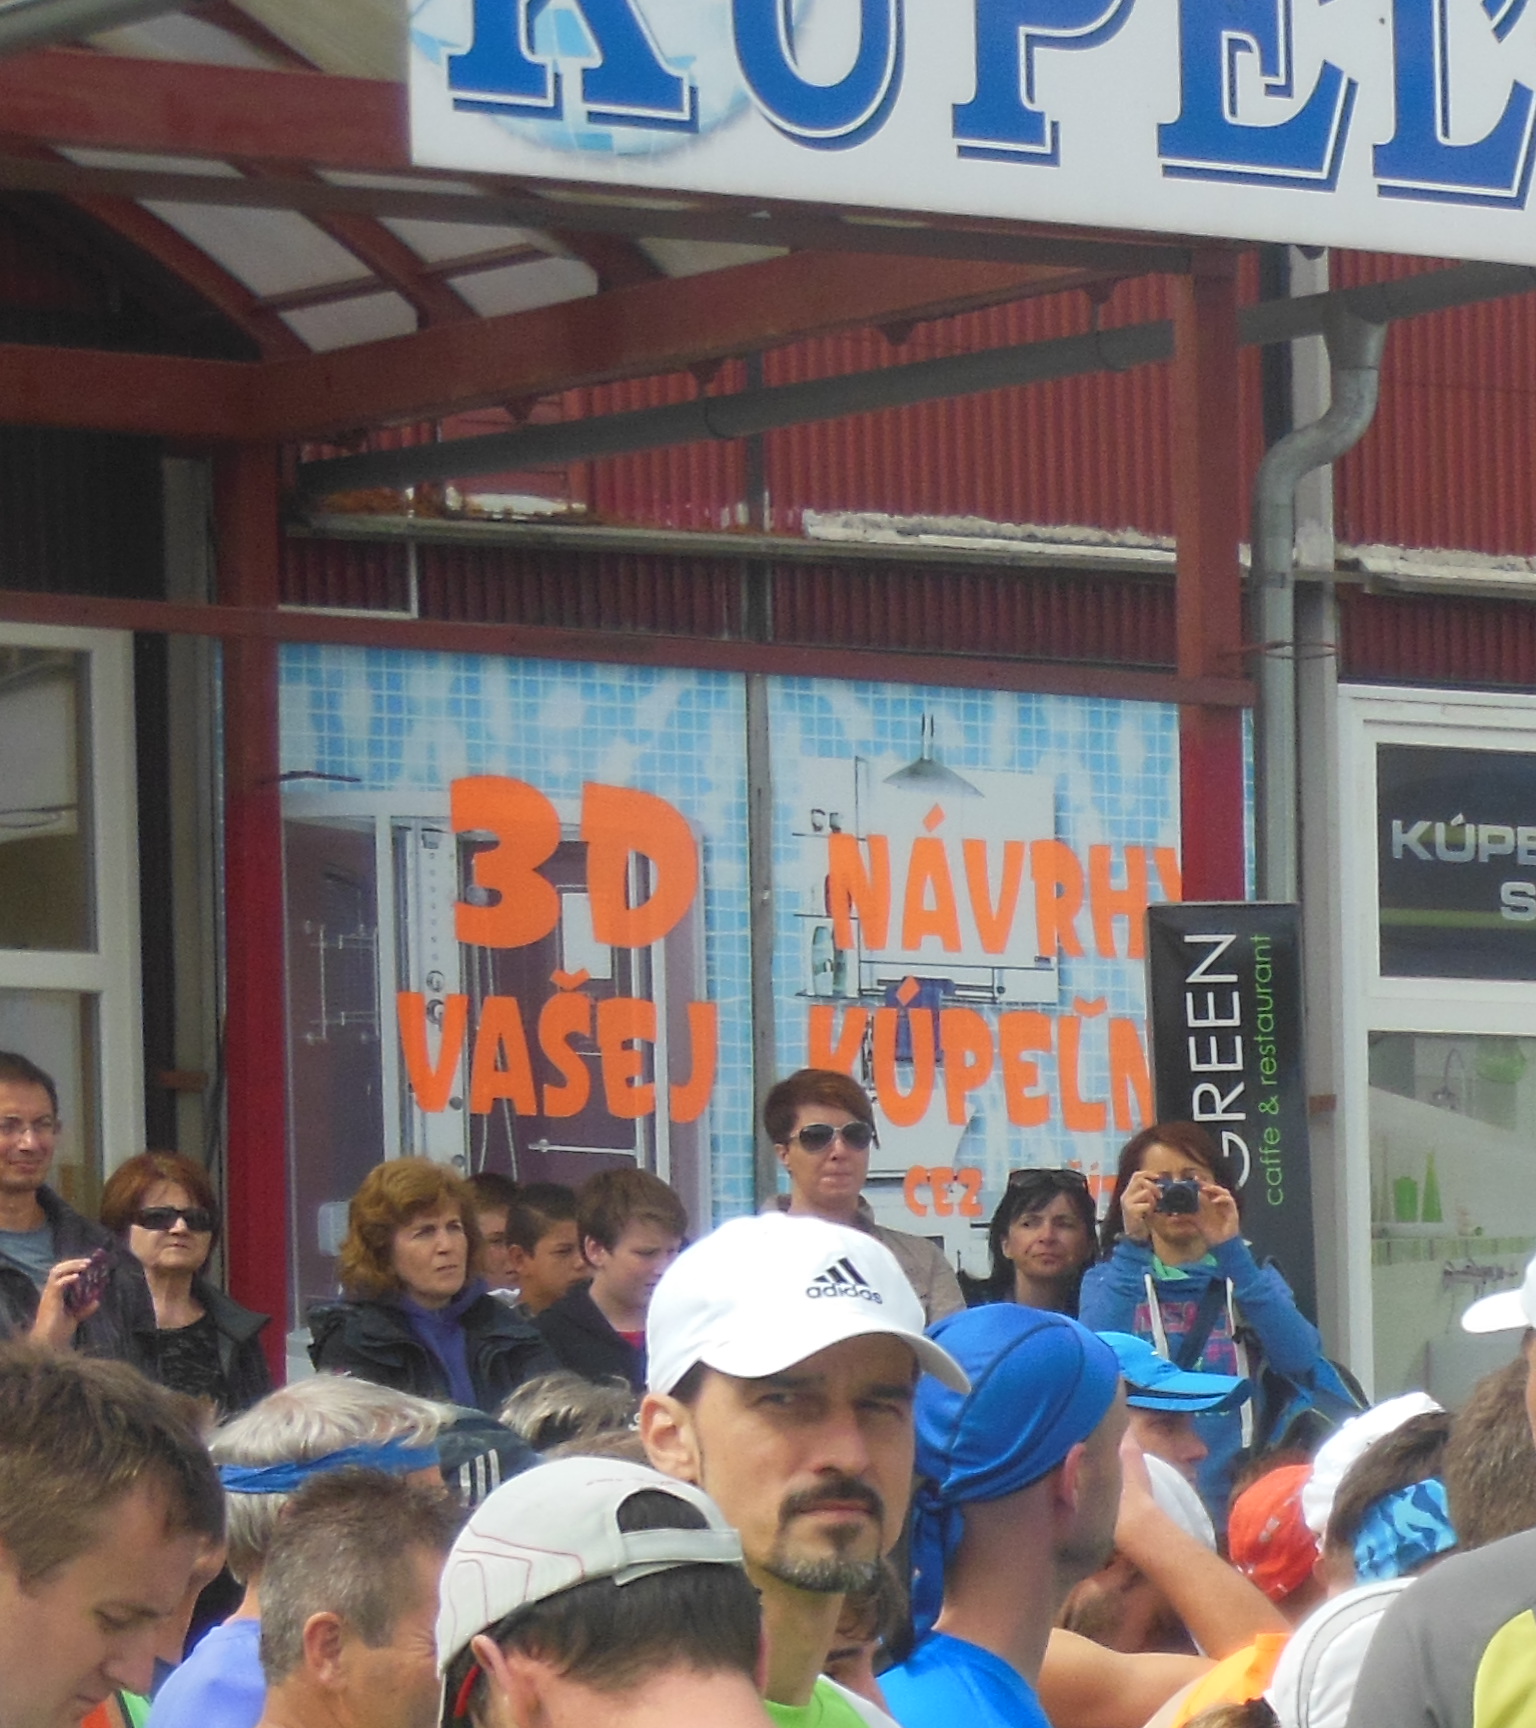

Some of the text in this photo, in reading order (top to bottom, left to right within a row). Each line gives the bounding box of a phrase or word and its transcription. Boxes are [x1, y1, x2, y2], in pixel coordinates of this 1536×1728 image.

[451, 774, 699, 949] 3D
[397, 967, 1156, 1133] VAŠEJ KÚPEĽN
[1250, 932, 1285, 1206] caffe & restaurant
[903, 1164, 984, 1217] CEZ
[805, 1281, 884, 1305] adidas
